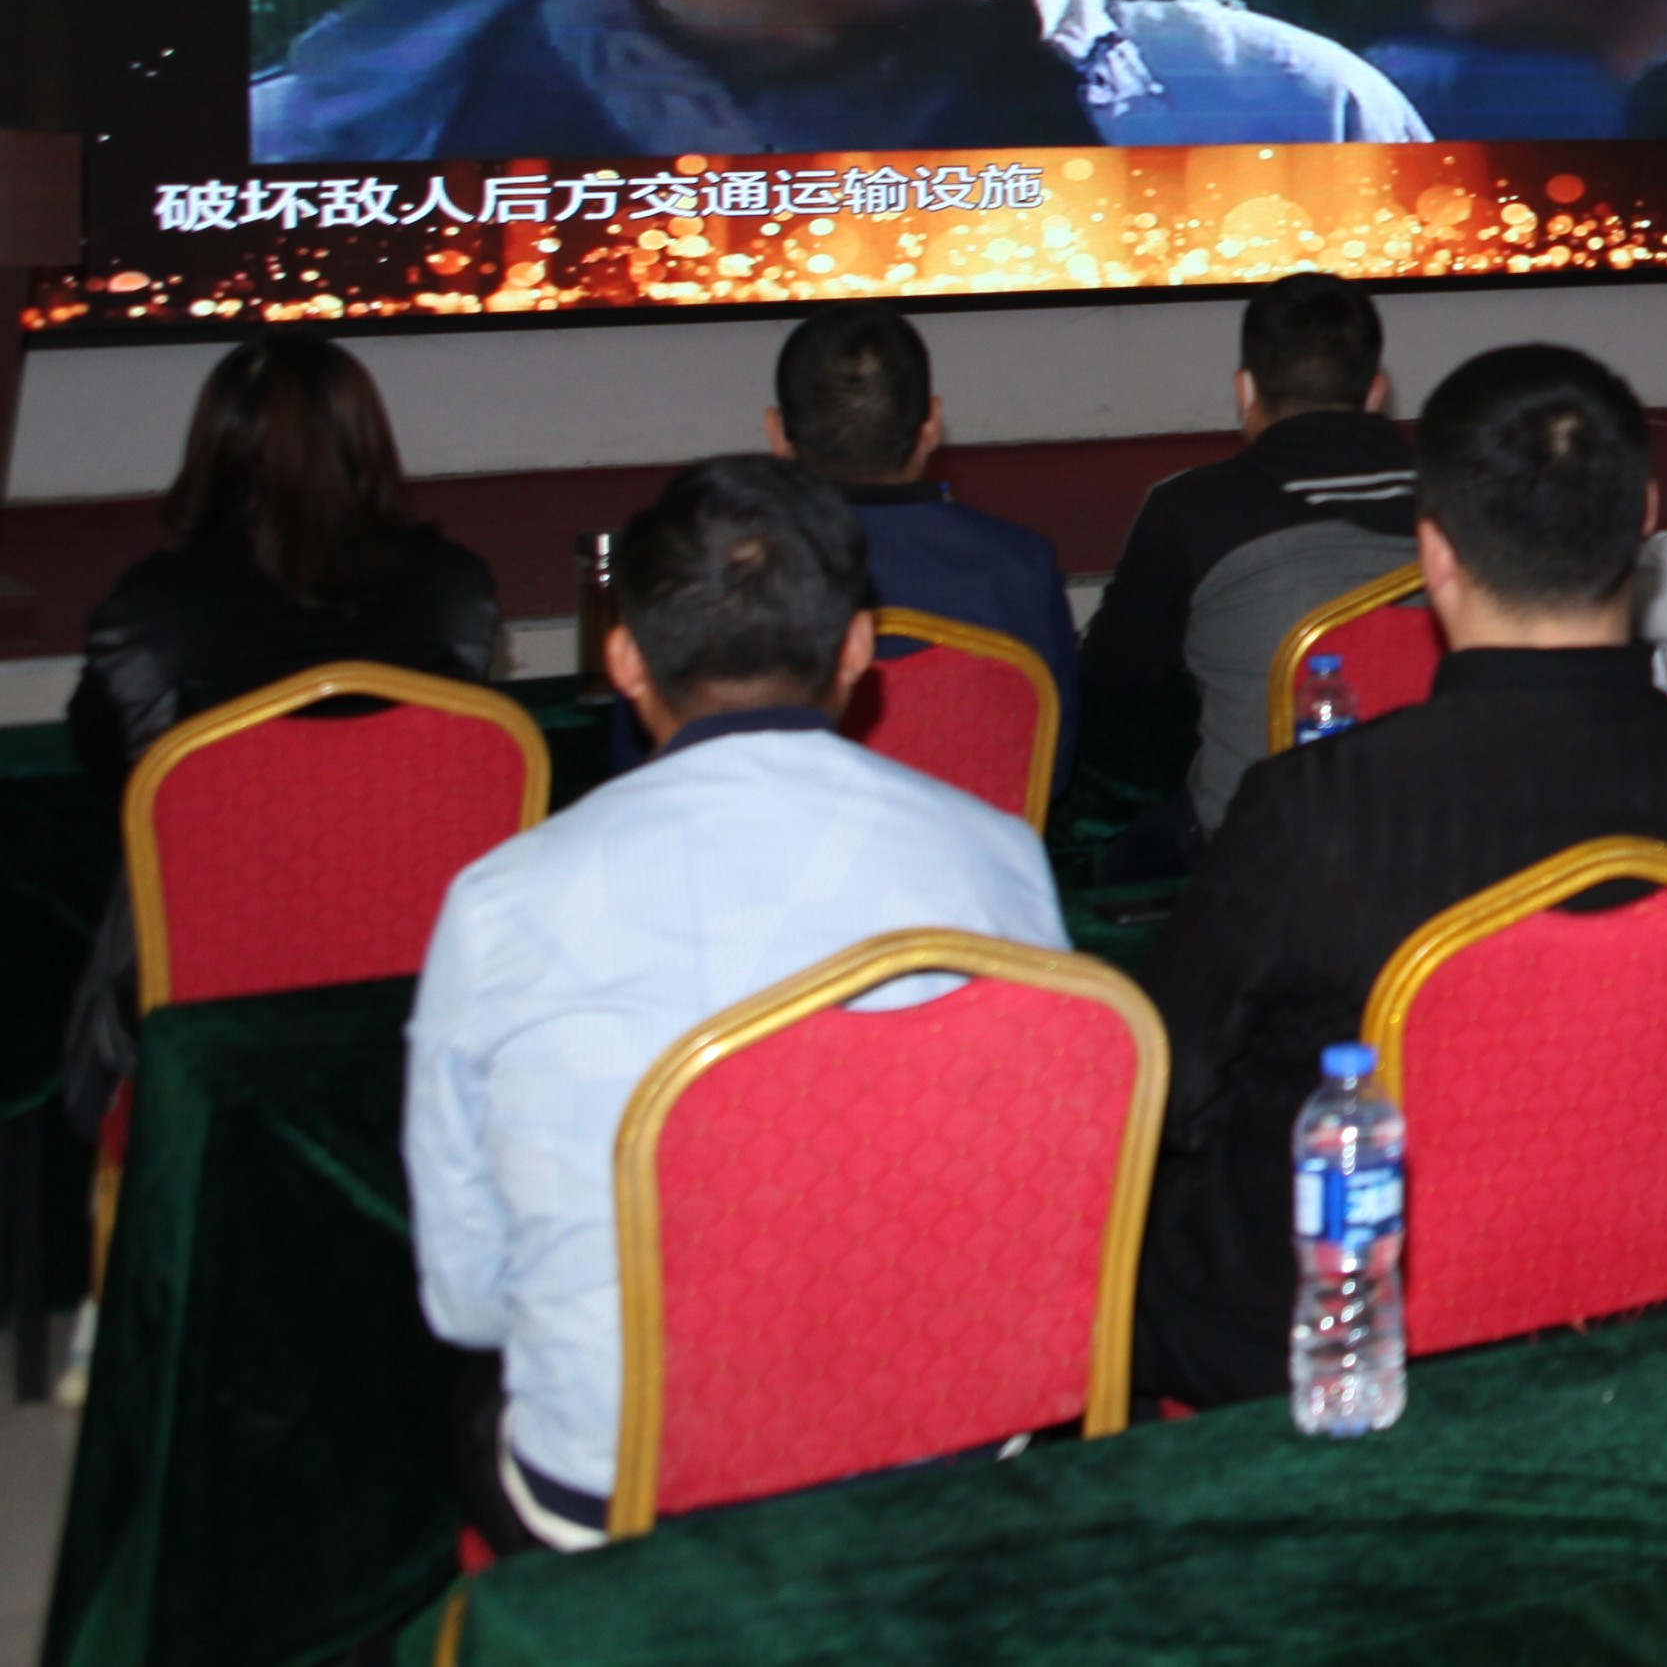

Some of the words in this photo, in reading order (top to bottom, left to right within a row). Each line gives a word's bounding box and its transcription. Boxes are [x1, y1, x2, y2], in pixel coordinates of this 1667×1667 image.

[154, 163, 1044, 231] 破坏敌人后方交通运输设施
